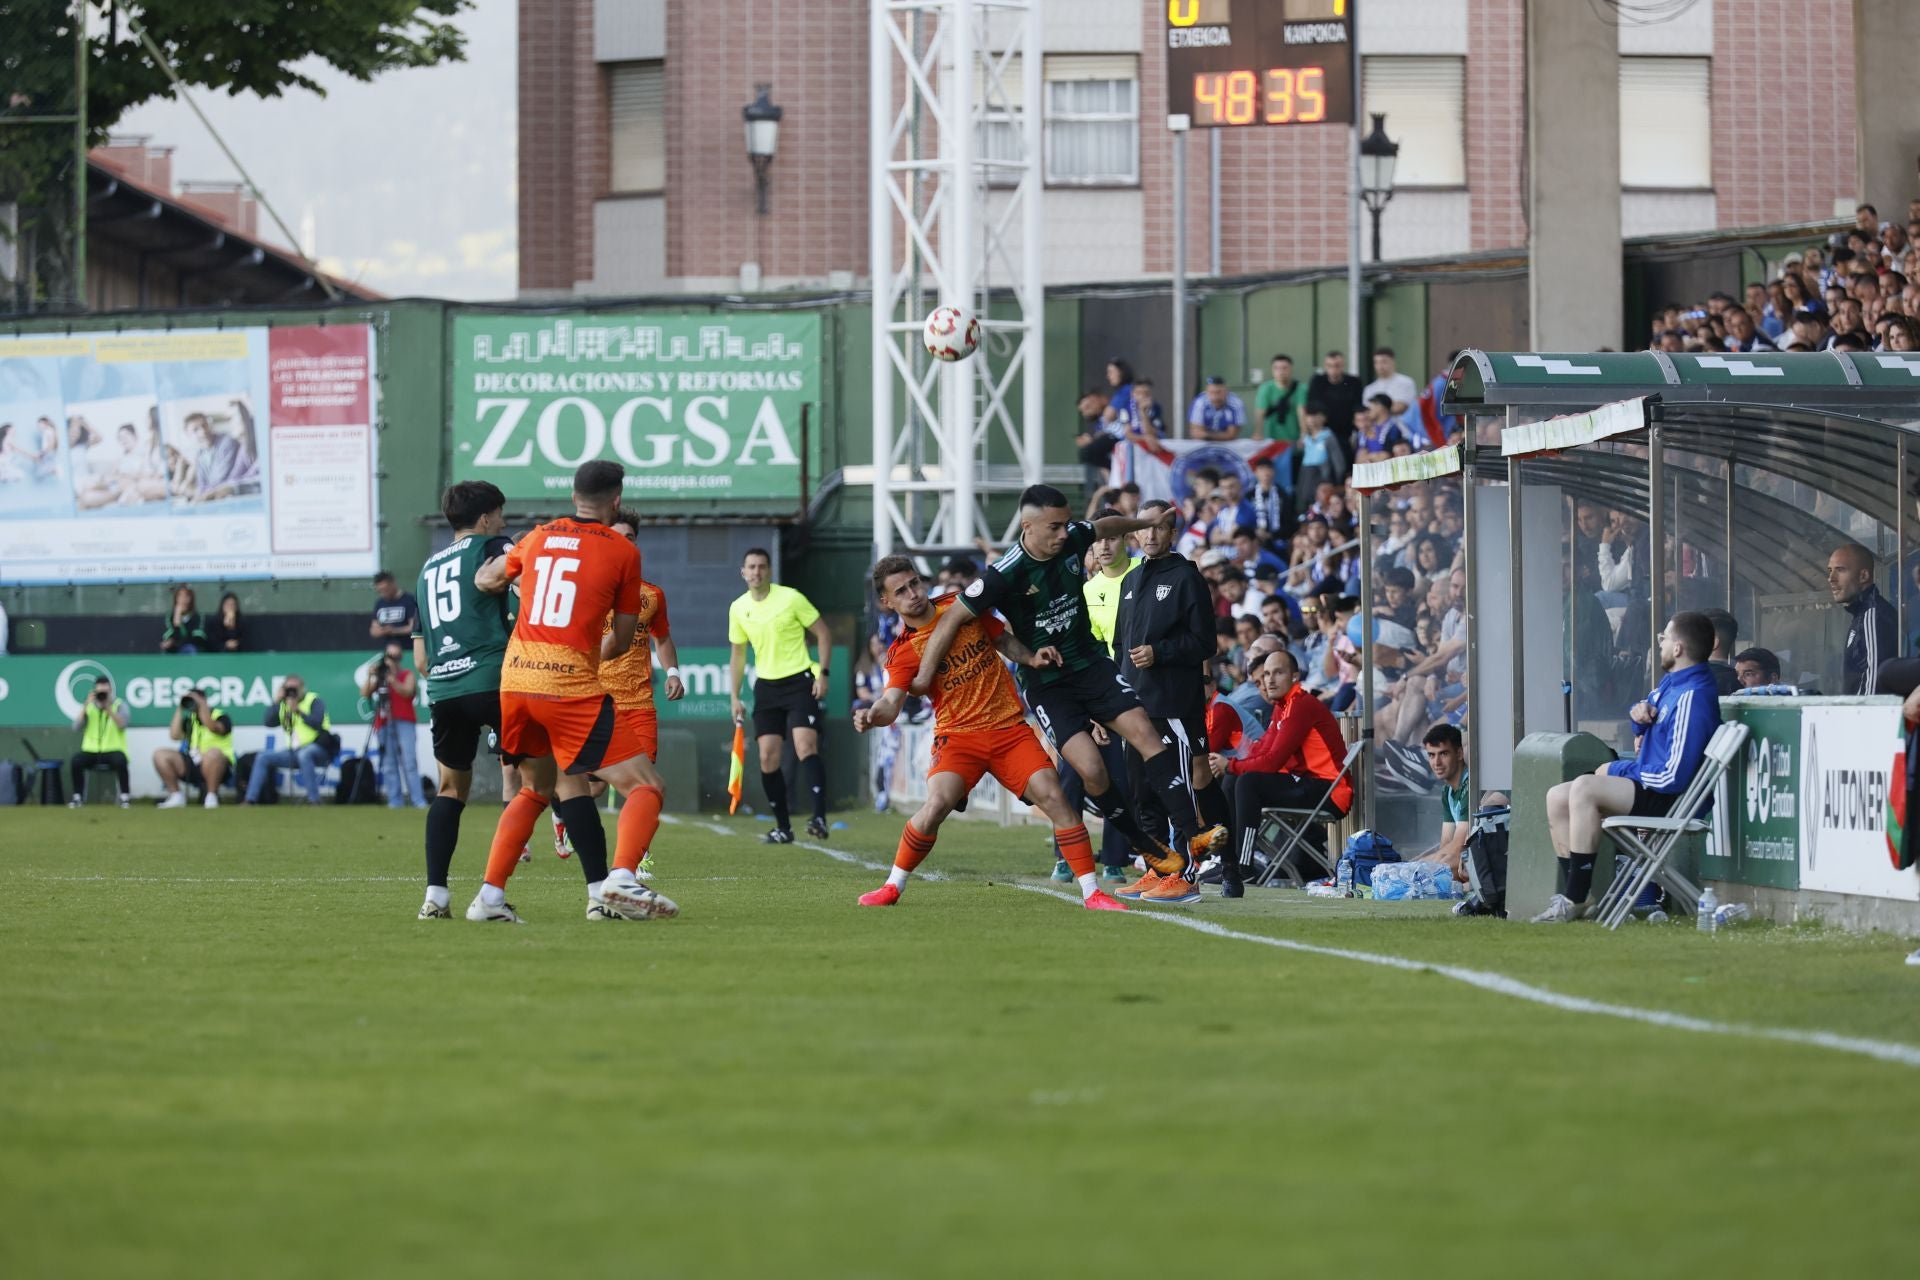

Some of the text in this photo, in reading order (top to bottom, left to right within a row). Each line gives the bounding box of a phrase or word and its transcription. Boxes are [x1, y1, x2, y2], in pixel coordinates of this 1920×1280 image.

[474, 370, 804, 393] DECORACIONES Y REFORMAS
[473, 396, 801, 468] ZOGSA
[424, 556, 462, 629] 15
[528, 556, 581, 629] 16
[520, 660, 576, 675] VALCARCE
